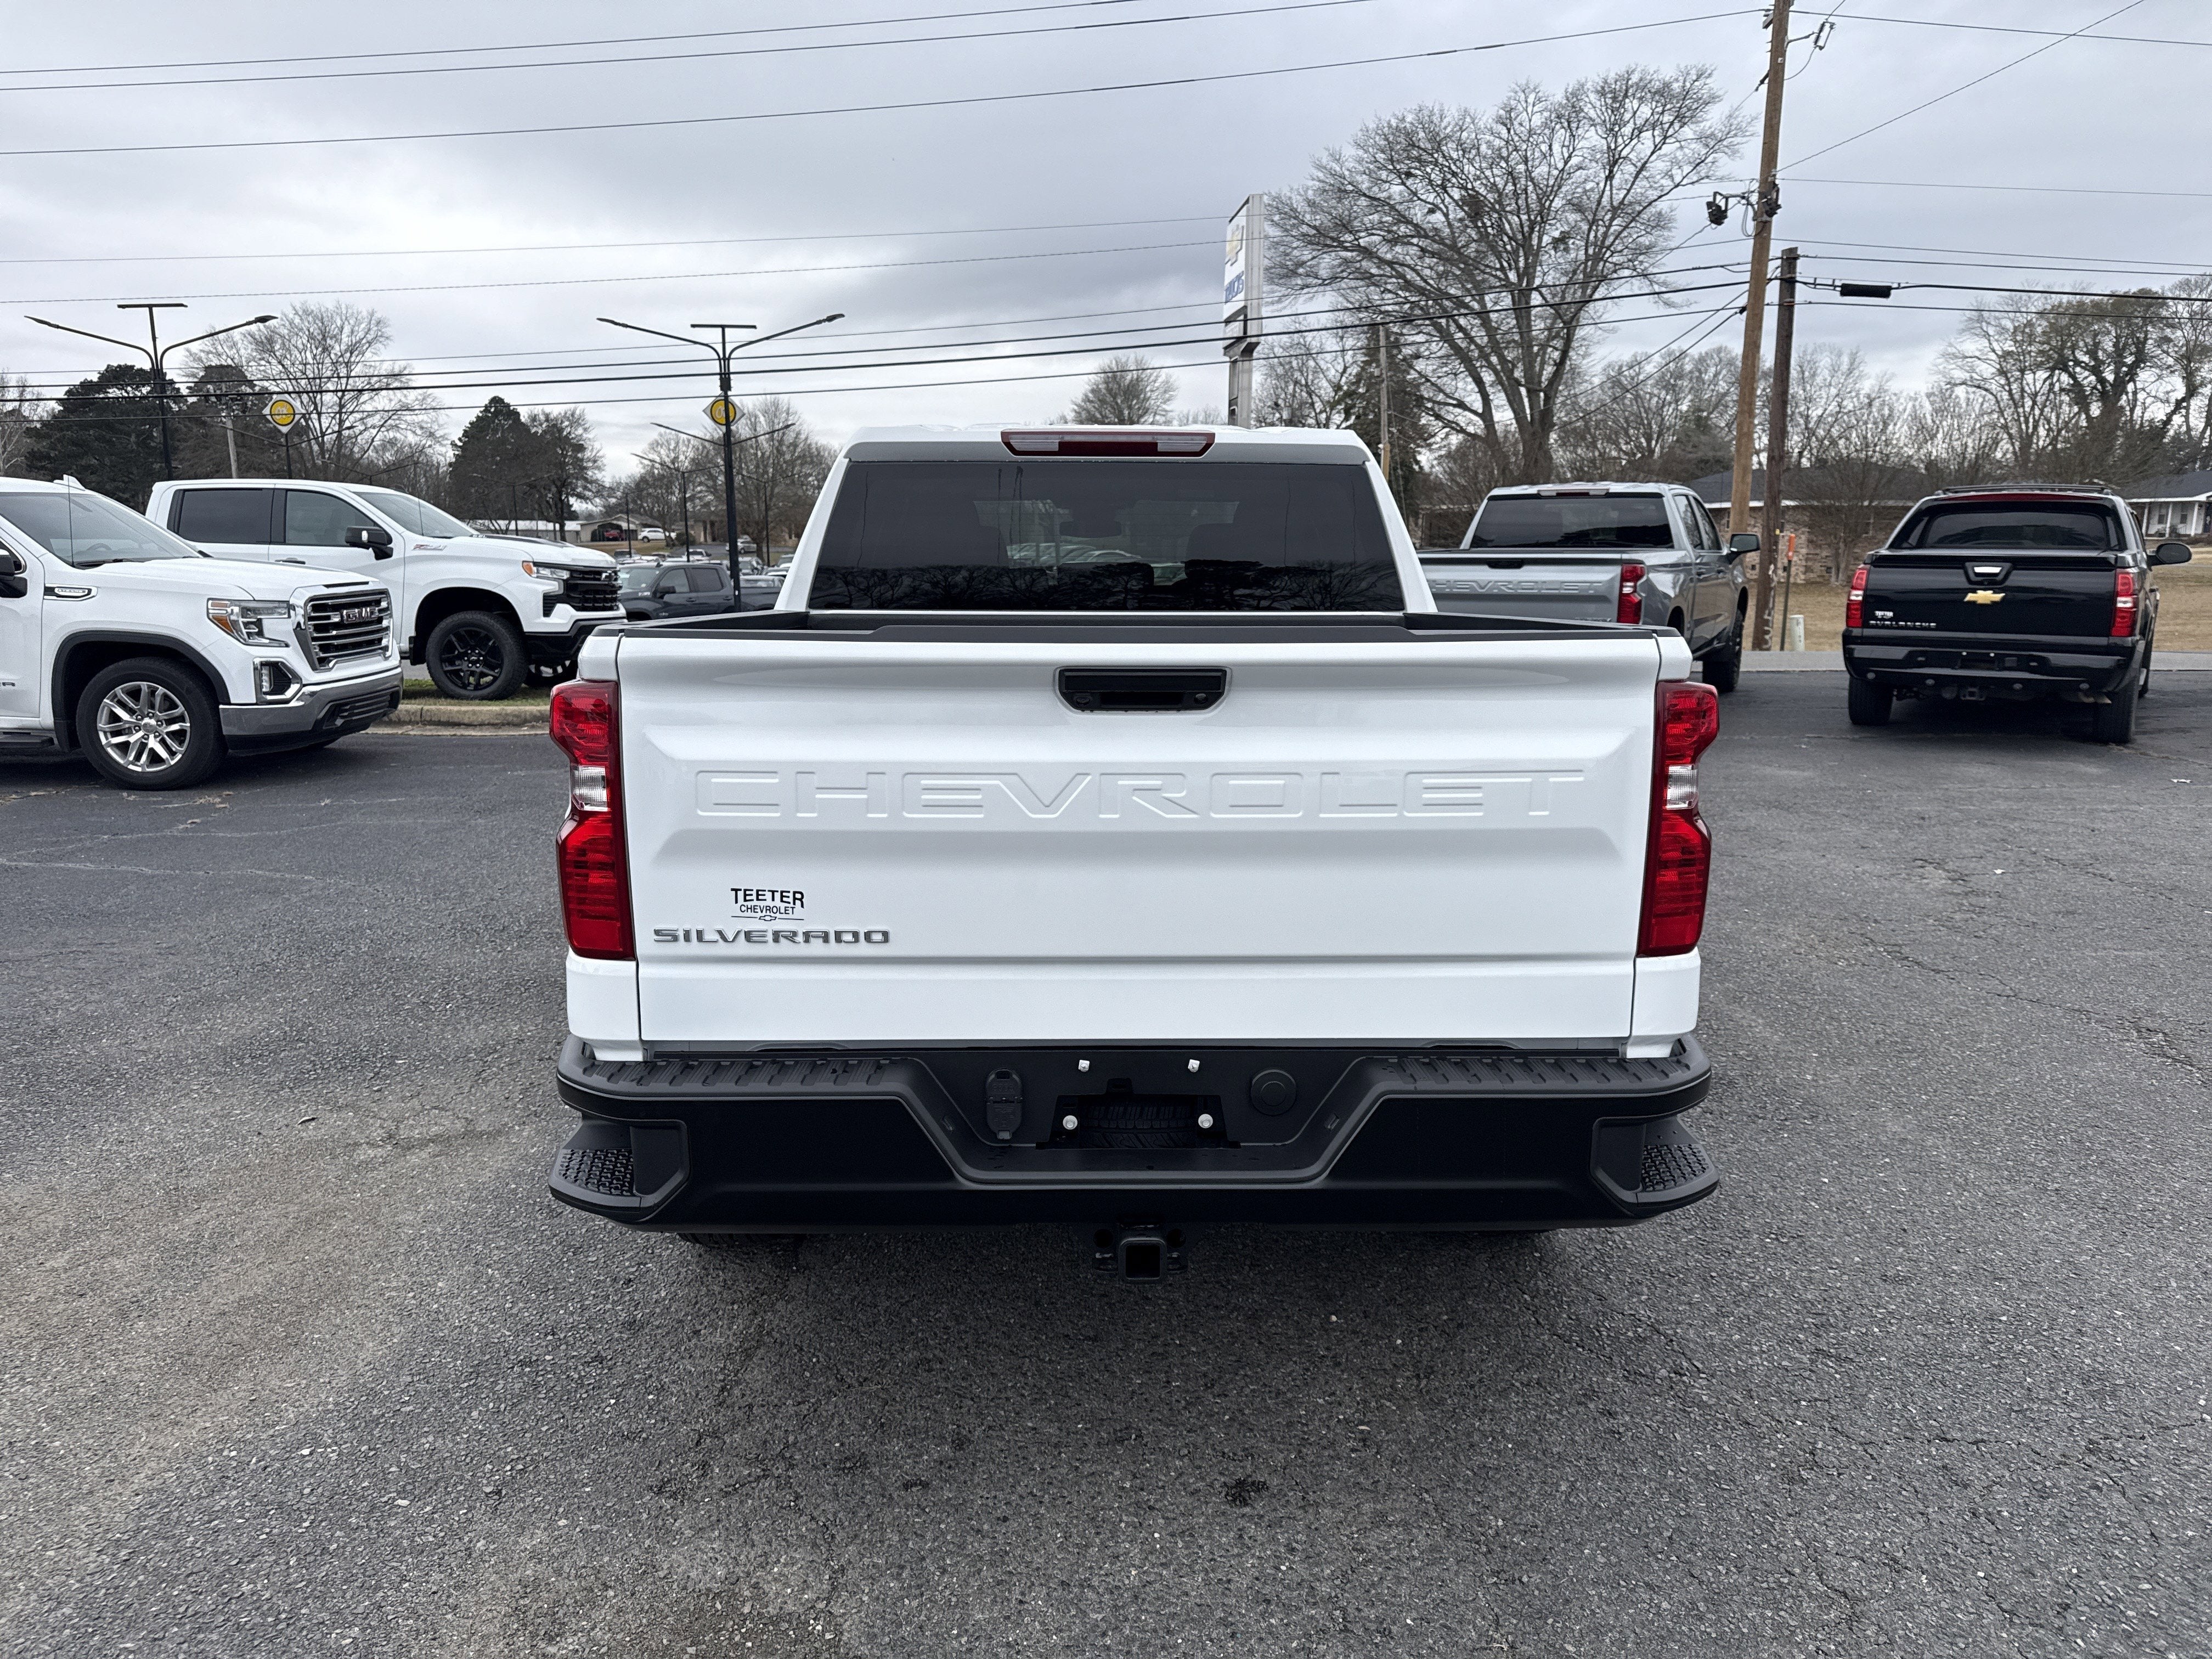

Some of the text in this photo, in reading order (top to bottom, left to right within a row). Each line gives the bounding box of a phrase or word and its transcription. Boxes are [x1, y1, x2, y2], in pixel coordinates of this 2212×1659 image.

[1426, 580, 1603, 593] HEVROLET
[342, 606, 379, 624] GMC
[695, 769, 1585, 819] CHEVROLET
[730, 888, 805, 909] TEETER
[740, 904, 796, 915] CHEVROLET
[653, 927, 890, 944] SILVERADO
